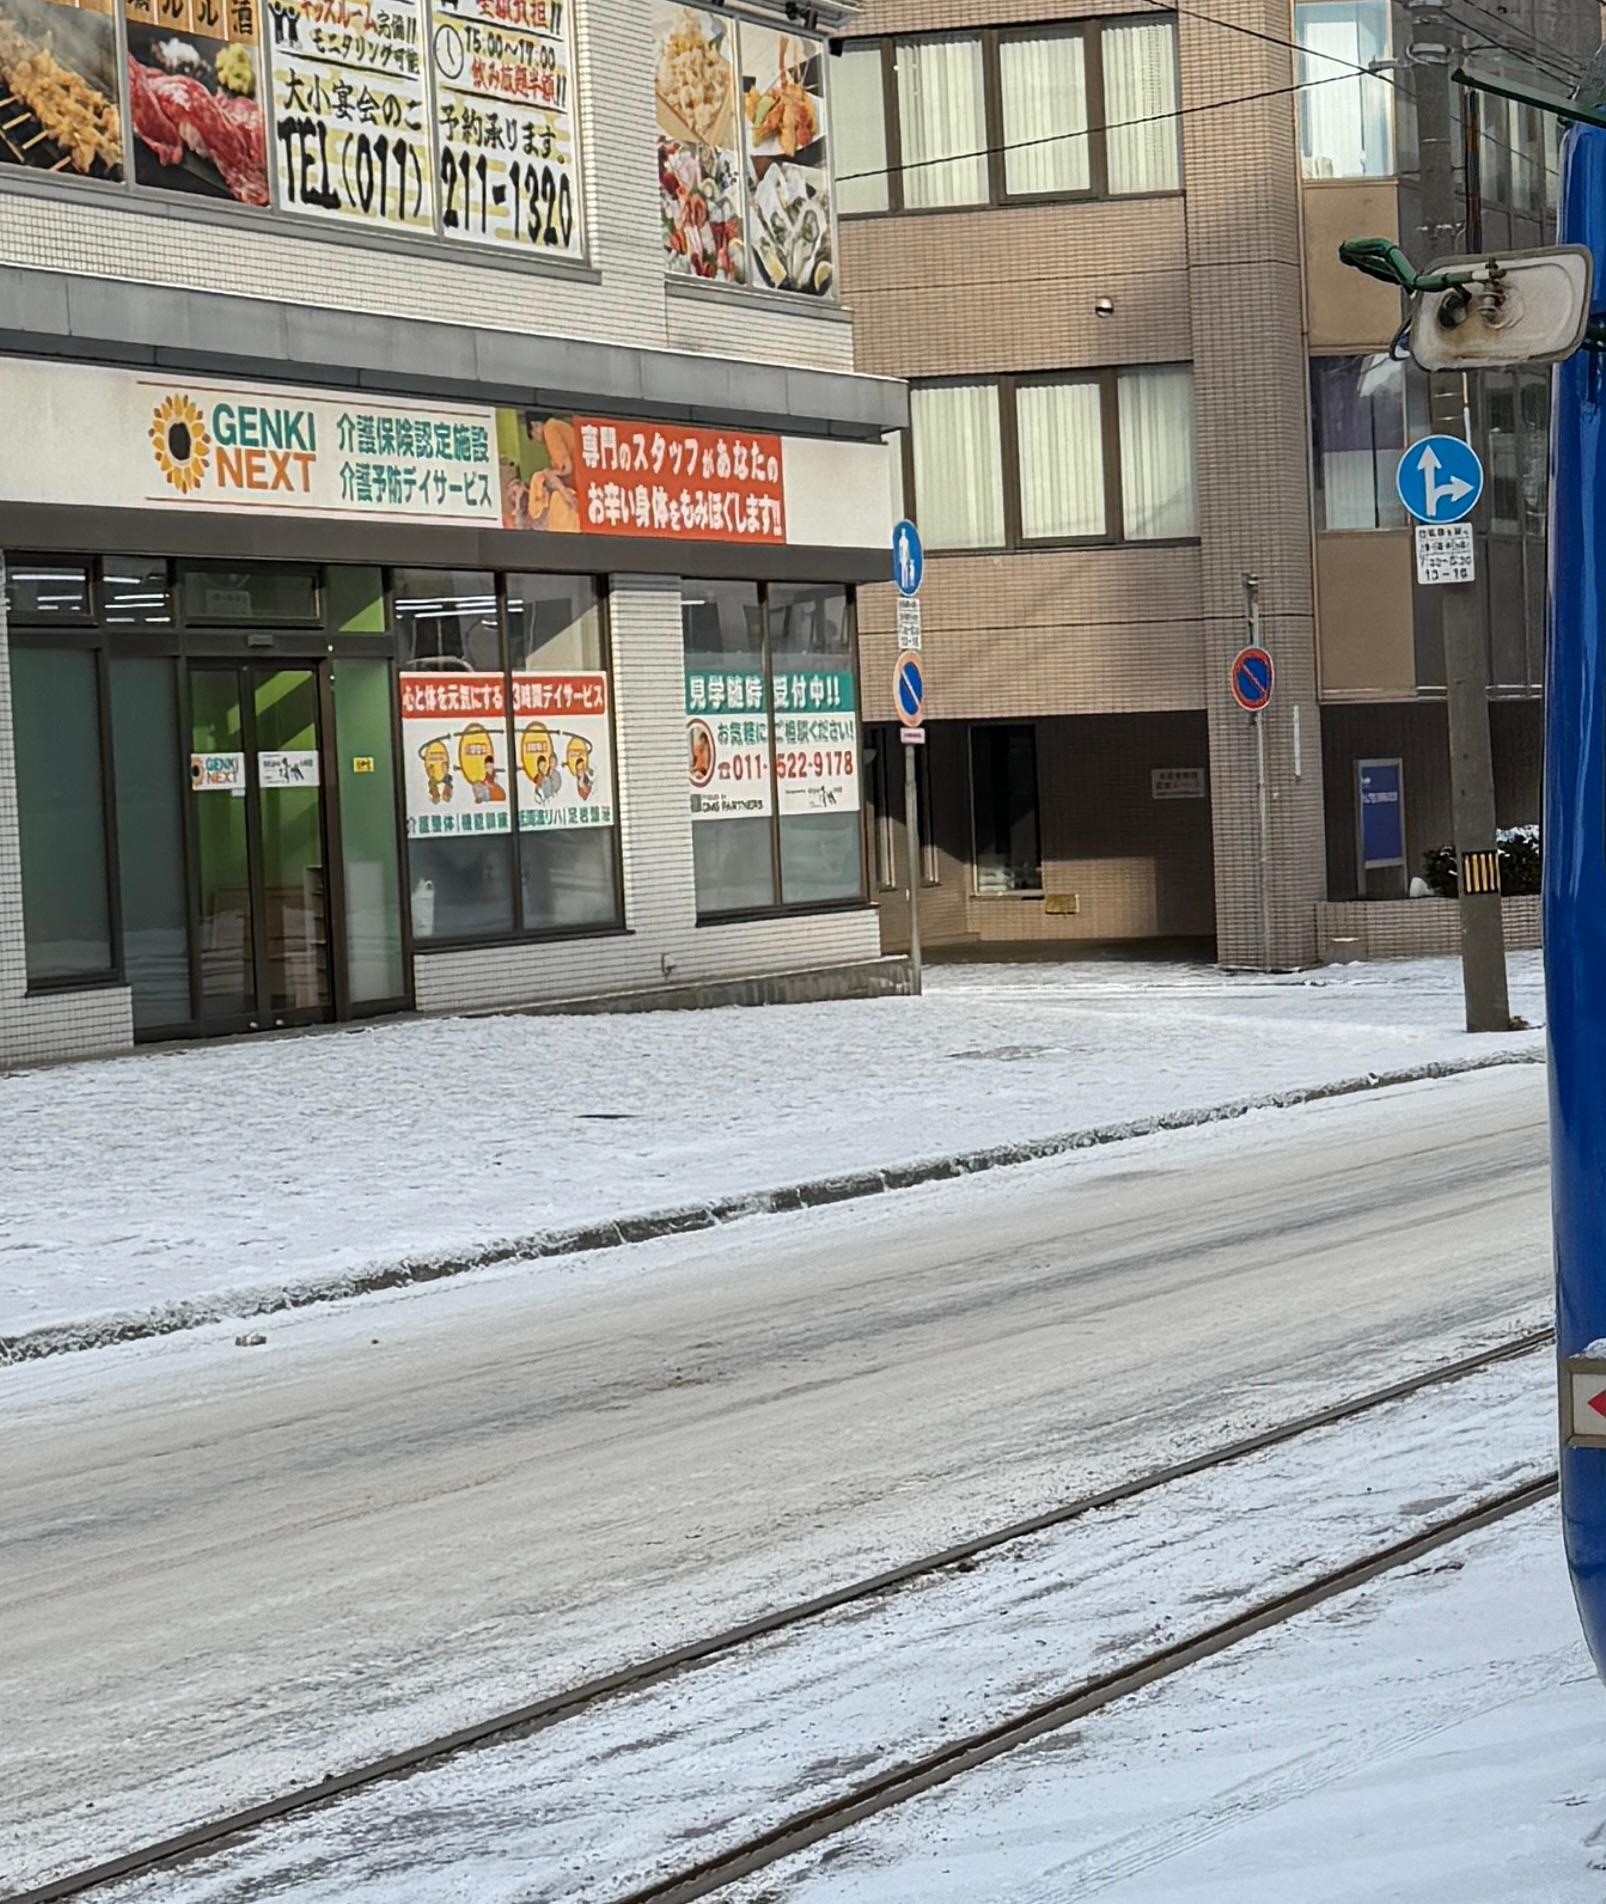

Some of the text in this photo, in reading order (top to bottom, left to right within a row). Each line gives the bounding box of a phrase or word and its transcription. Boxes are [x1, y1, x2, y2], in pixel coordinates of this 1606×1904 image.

[212, 402, 316, 451] GENKI
[336, 412, 490, 463] 介護保険認定施設
[215, 447, 317, 493] NEXT
[580, 424, 779, 483] 専門のスタッフがあなたの
[338, 460, 492, 508] 介護予防デイサービス
